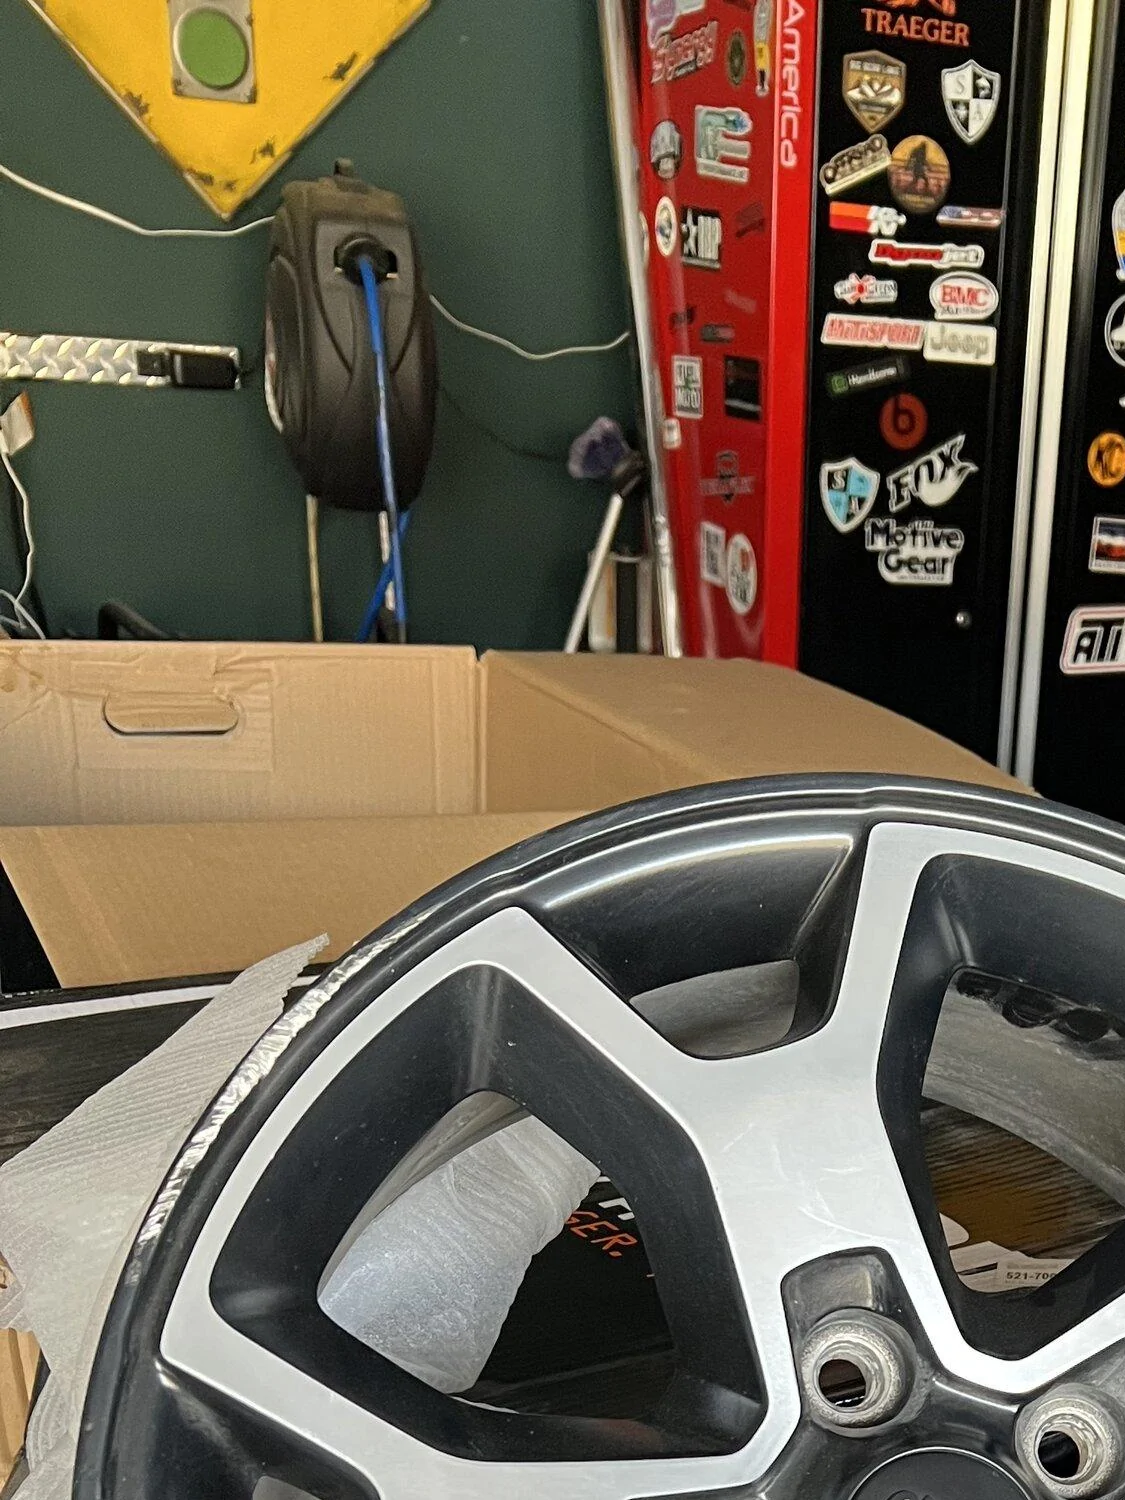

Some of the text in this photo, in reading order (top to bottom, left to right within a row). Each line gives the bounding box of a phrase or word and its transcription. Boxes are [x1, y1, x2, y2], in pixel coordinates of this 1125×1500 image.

[861, 8, 969, 47] TRAEGER
[869, 518, 960, 550] Motive
[884, 549, 950, 575] Gear
